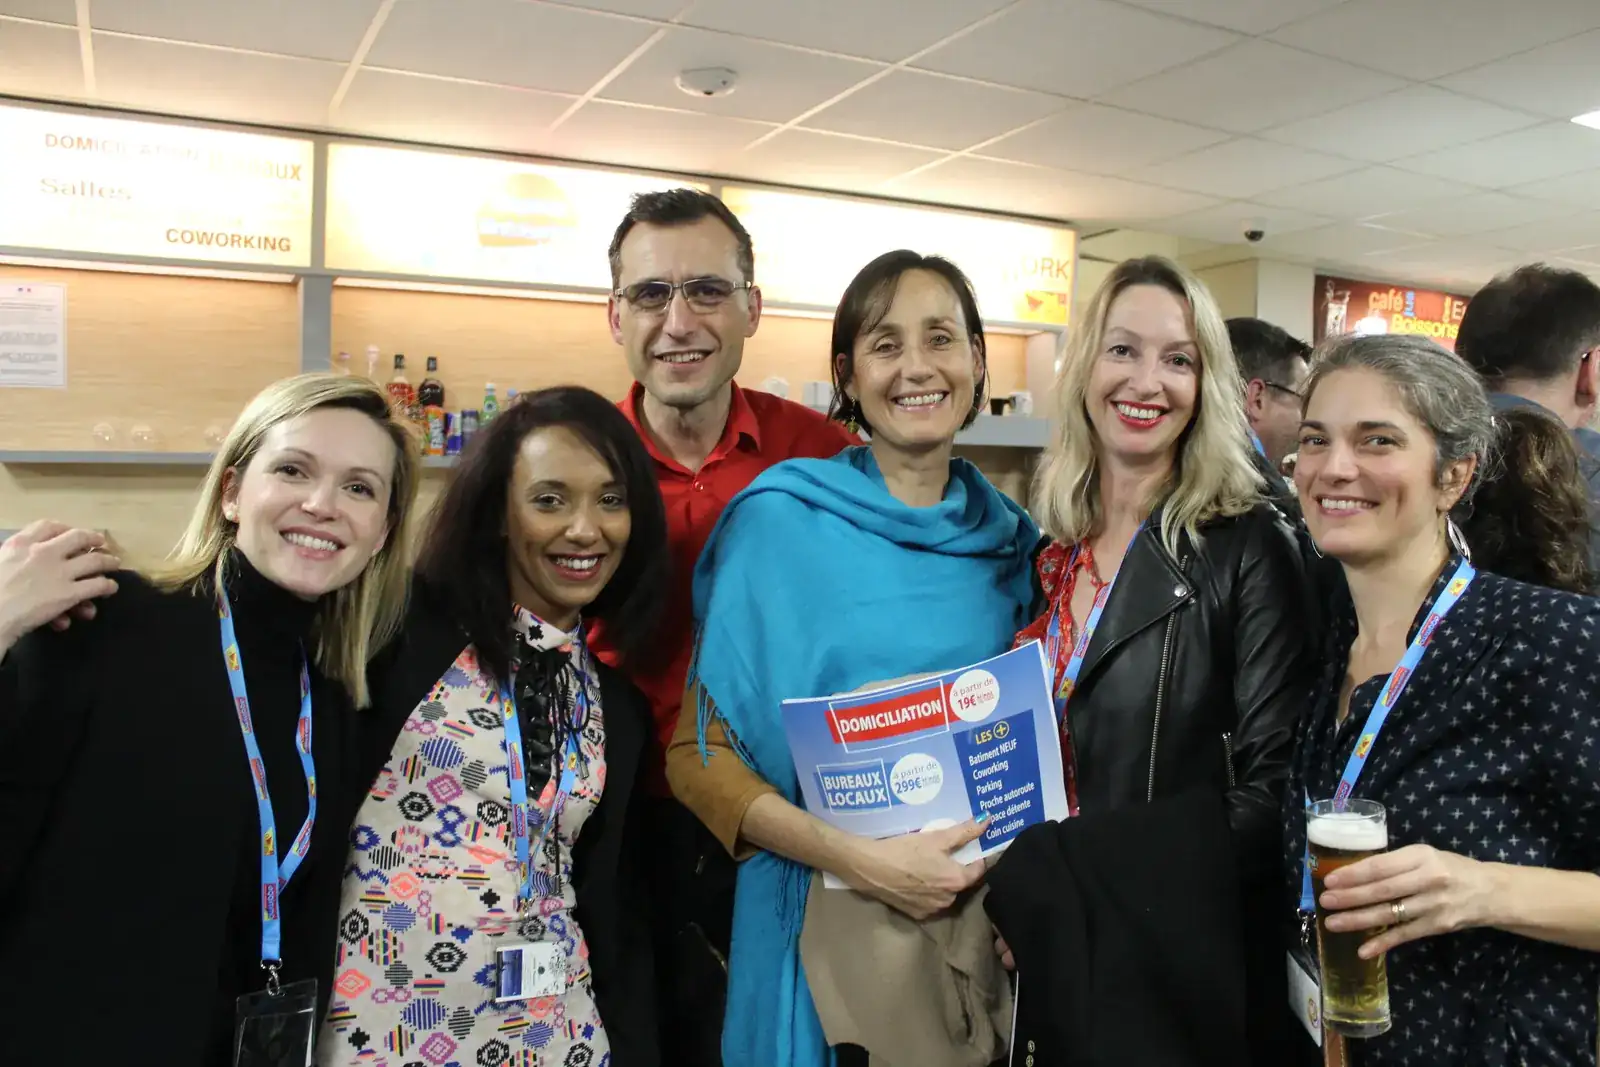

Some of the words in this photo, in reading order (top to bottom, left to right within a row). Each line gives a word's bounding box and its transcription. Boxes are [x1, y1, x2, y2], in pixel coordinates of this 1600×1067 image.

[166, 228, 291, 252] COWORKING
[1391, 313, 1459, 339] Boissons
[960, 682, 982, 695] partir
[984, 677, 994, 687] de
[957, 695, 977, 710] 19€
[840, 699, 942, 734] DOMICILIATION
[976, 729, 993, 745] LES
[1000, 738, 1018, 754] NEUF
[901, 766, 924, 778] partir
[927, 761, 937, 770] de
[973, 760, 1009, 780] Coworking
[823, 771, 882, 790] BUREAUX
[895, 777, 922, 794] 299€
[976, 779, 1002, 796] Parking
[827, 787, 887, 806] LOCAUX
[980, 795, 1003, 811] Proche
[1004, 781, 1035, 802] autoroute
[1006, 799, 1031, 816] détente
[986, 827, 1002, 840] Coin
[1002, 818, 1025, 834] cuisine
